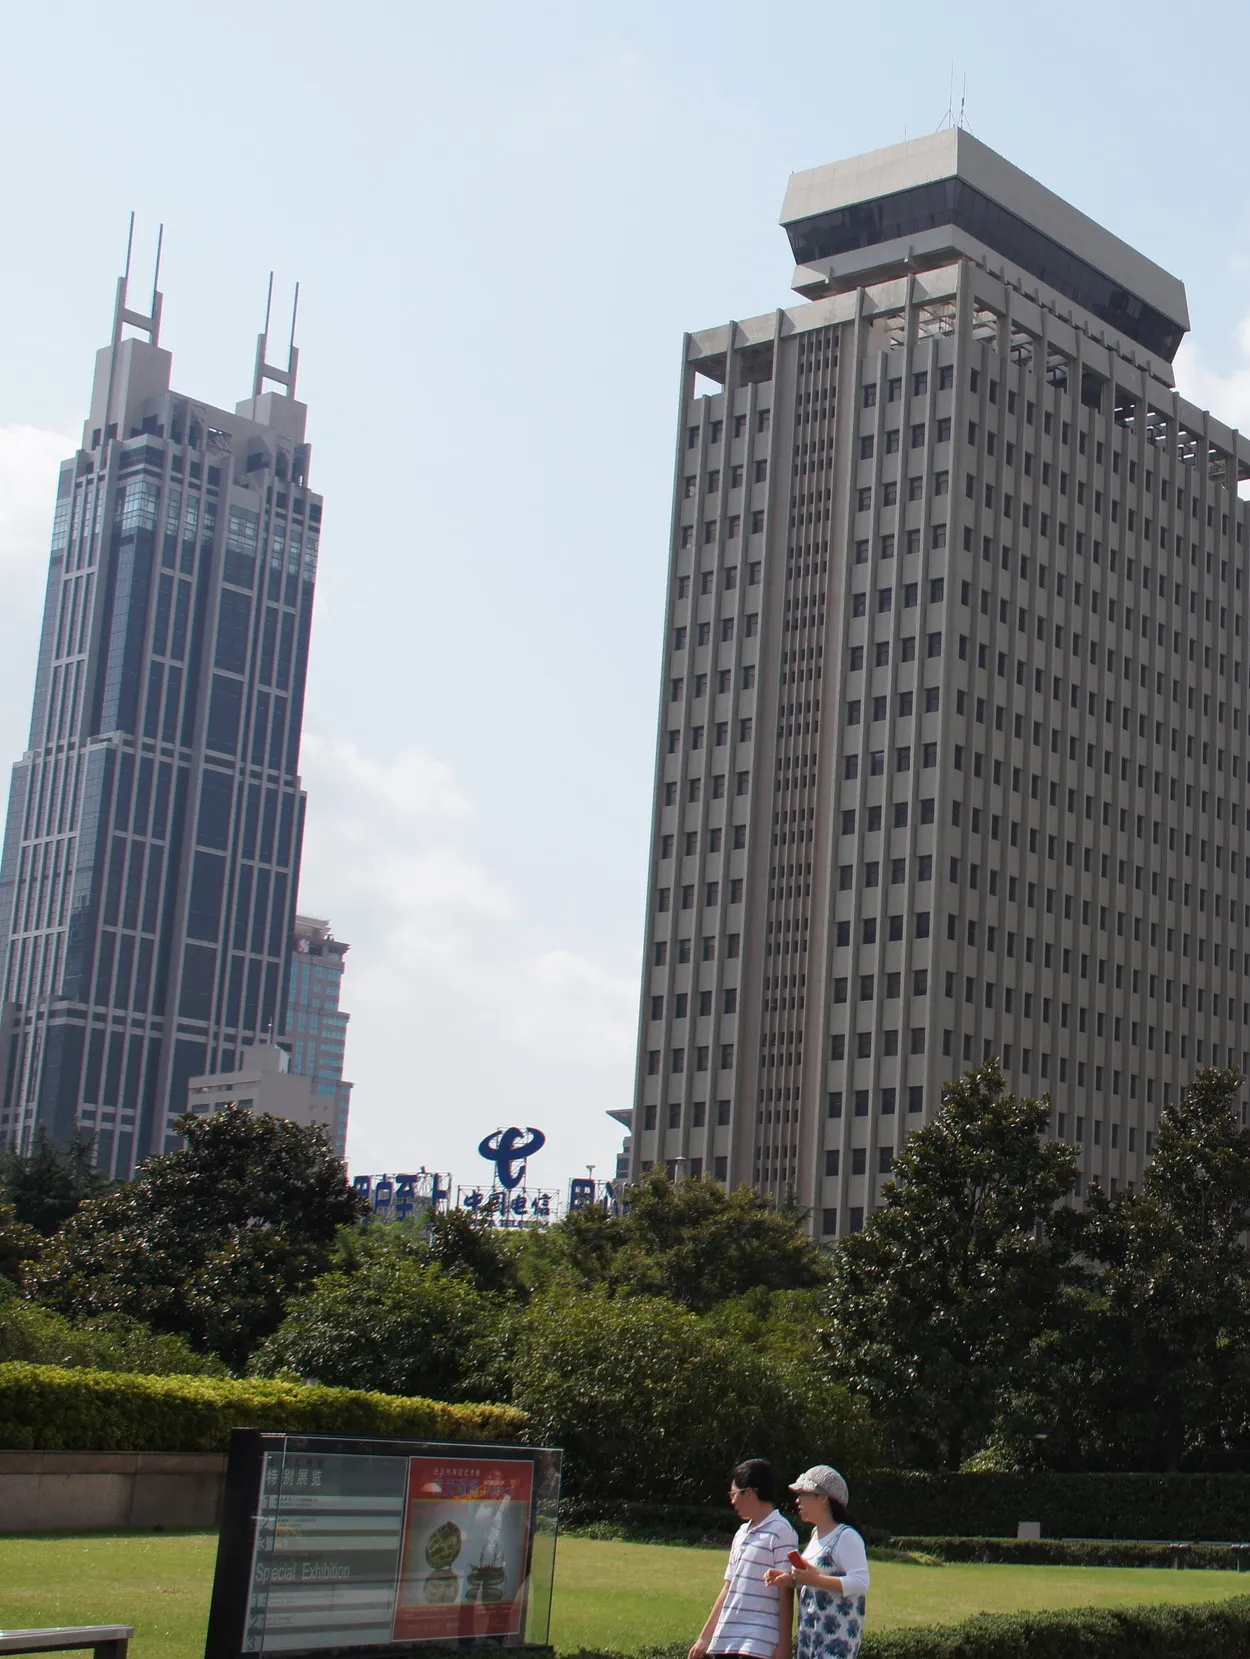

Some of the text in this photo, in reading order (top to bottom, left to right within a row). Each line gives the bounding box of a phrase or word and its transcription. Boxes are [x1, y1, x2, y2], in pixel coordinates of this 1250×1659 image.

[265, 1468, 323, 1487] 特别展览
[255, 1562, 351, 1584] Special Exhibition
